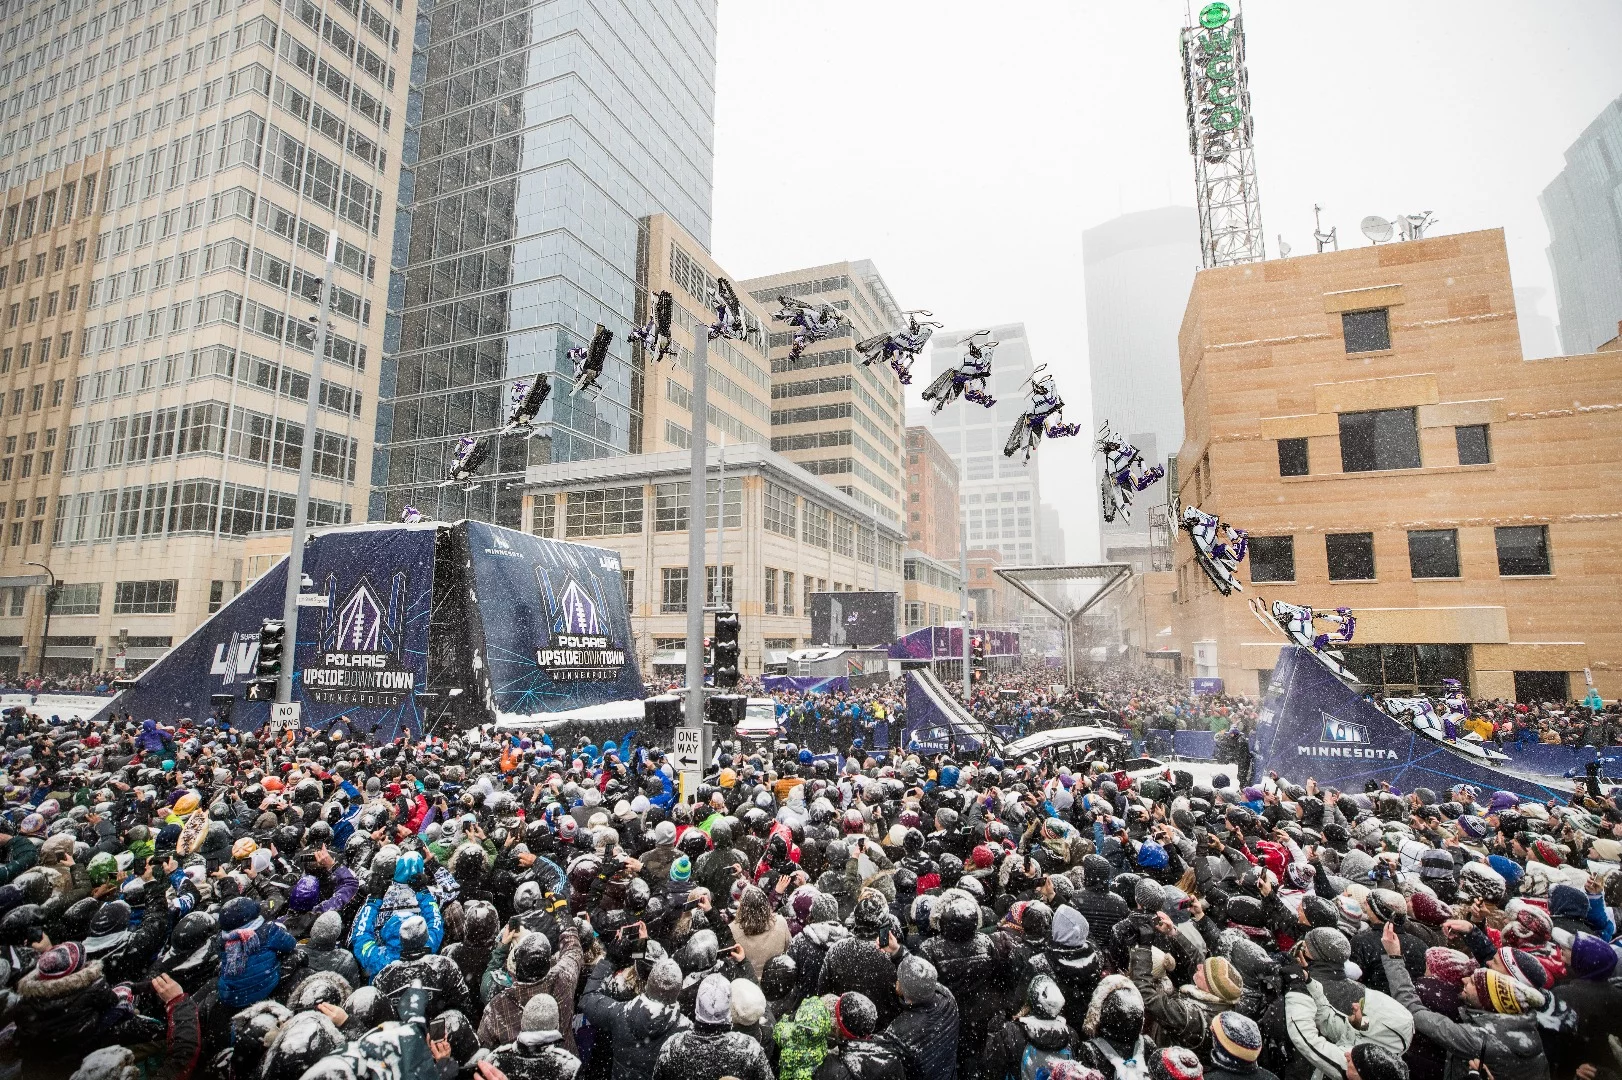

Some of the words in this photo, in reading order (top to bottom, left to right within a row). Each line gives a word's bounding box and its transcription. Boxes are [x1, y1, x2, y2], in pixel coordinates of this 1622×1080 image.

[1197, 29, 1243, 131] WCCO
[558, 636, 606, 648] POLARIS
[325, 653, 387, 668] POLARIS
[537, 650, 625, 667] UPSIDEDOWNTOWN
[303, 668, 414, 690] UPSIDEDOWNTOWN
[279, 707, 293, 716] NO
[271, 718, 299, 728] TURNS
[678, 731, 699, 742] ONE
[677, 743, 699, 754] WAY
[1298, 745, 1399, 760] MINNESOTA
